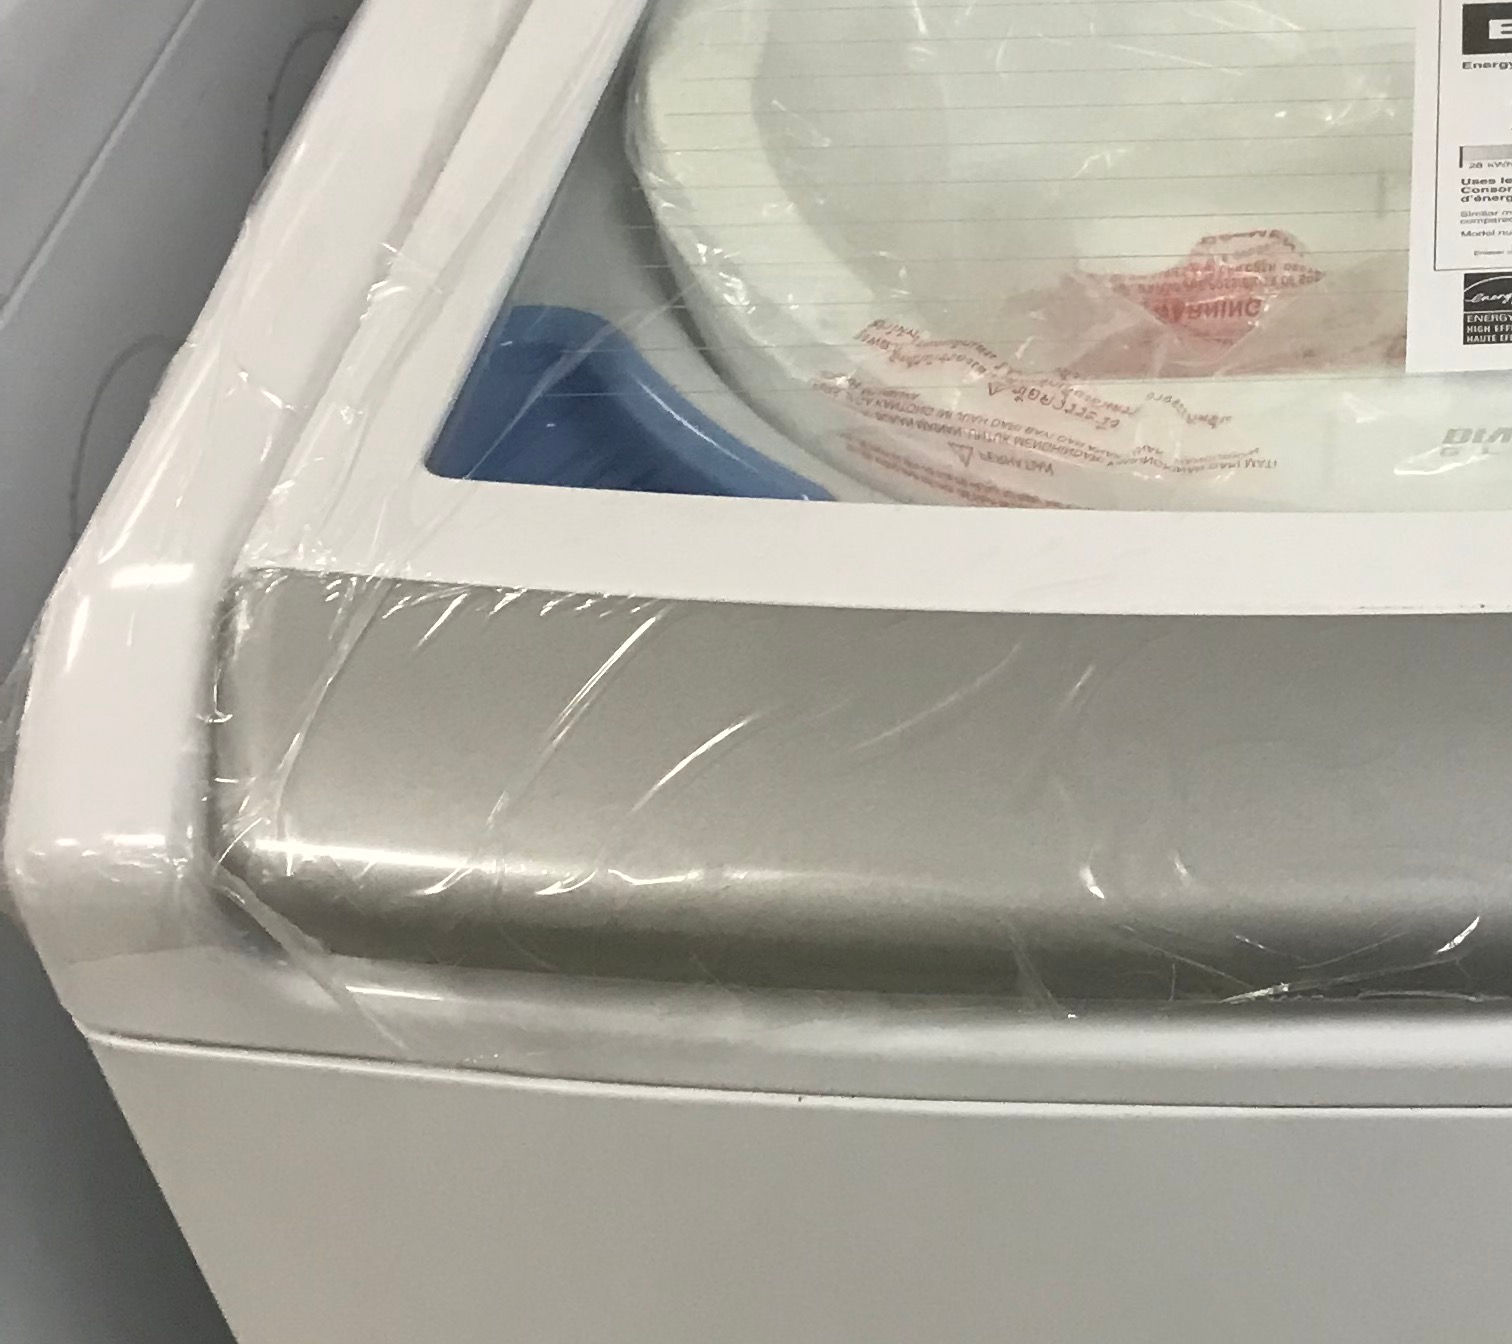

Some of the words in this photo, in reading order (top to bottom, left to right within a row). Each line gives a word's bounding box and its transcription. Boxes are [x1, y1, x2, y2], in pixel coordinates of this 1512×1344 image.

[1460, 177, 1497, 186] Uses
[1466, 324, 1491, 334] HIGH
[1466, 333, 1497, 343] HAUTE
